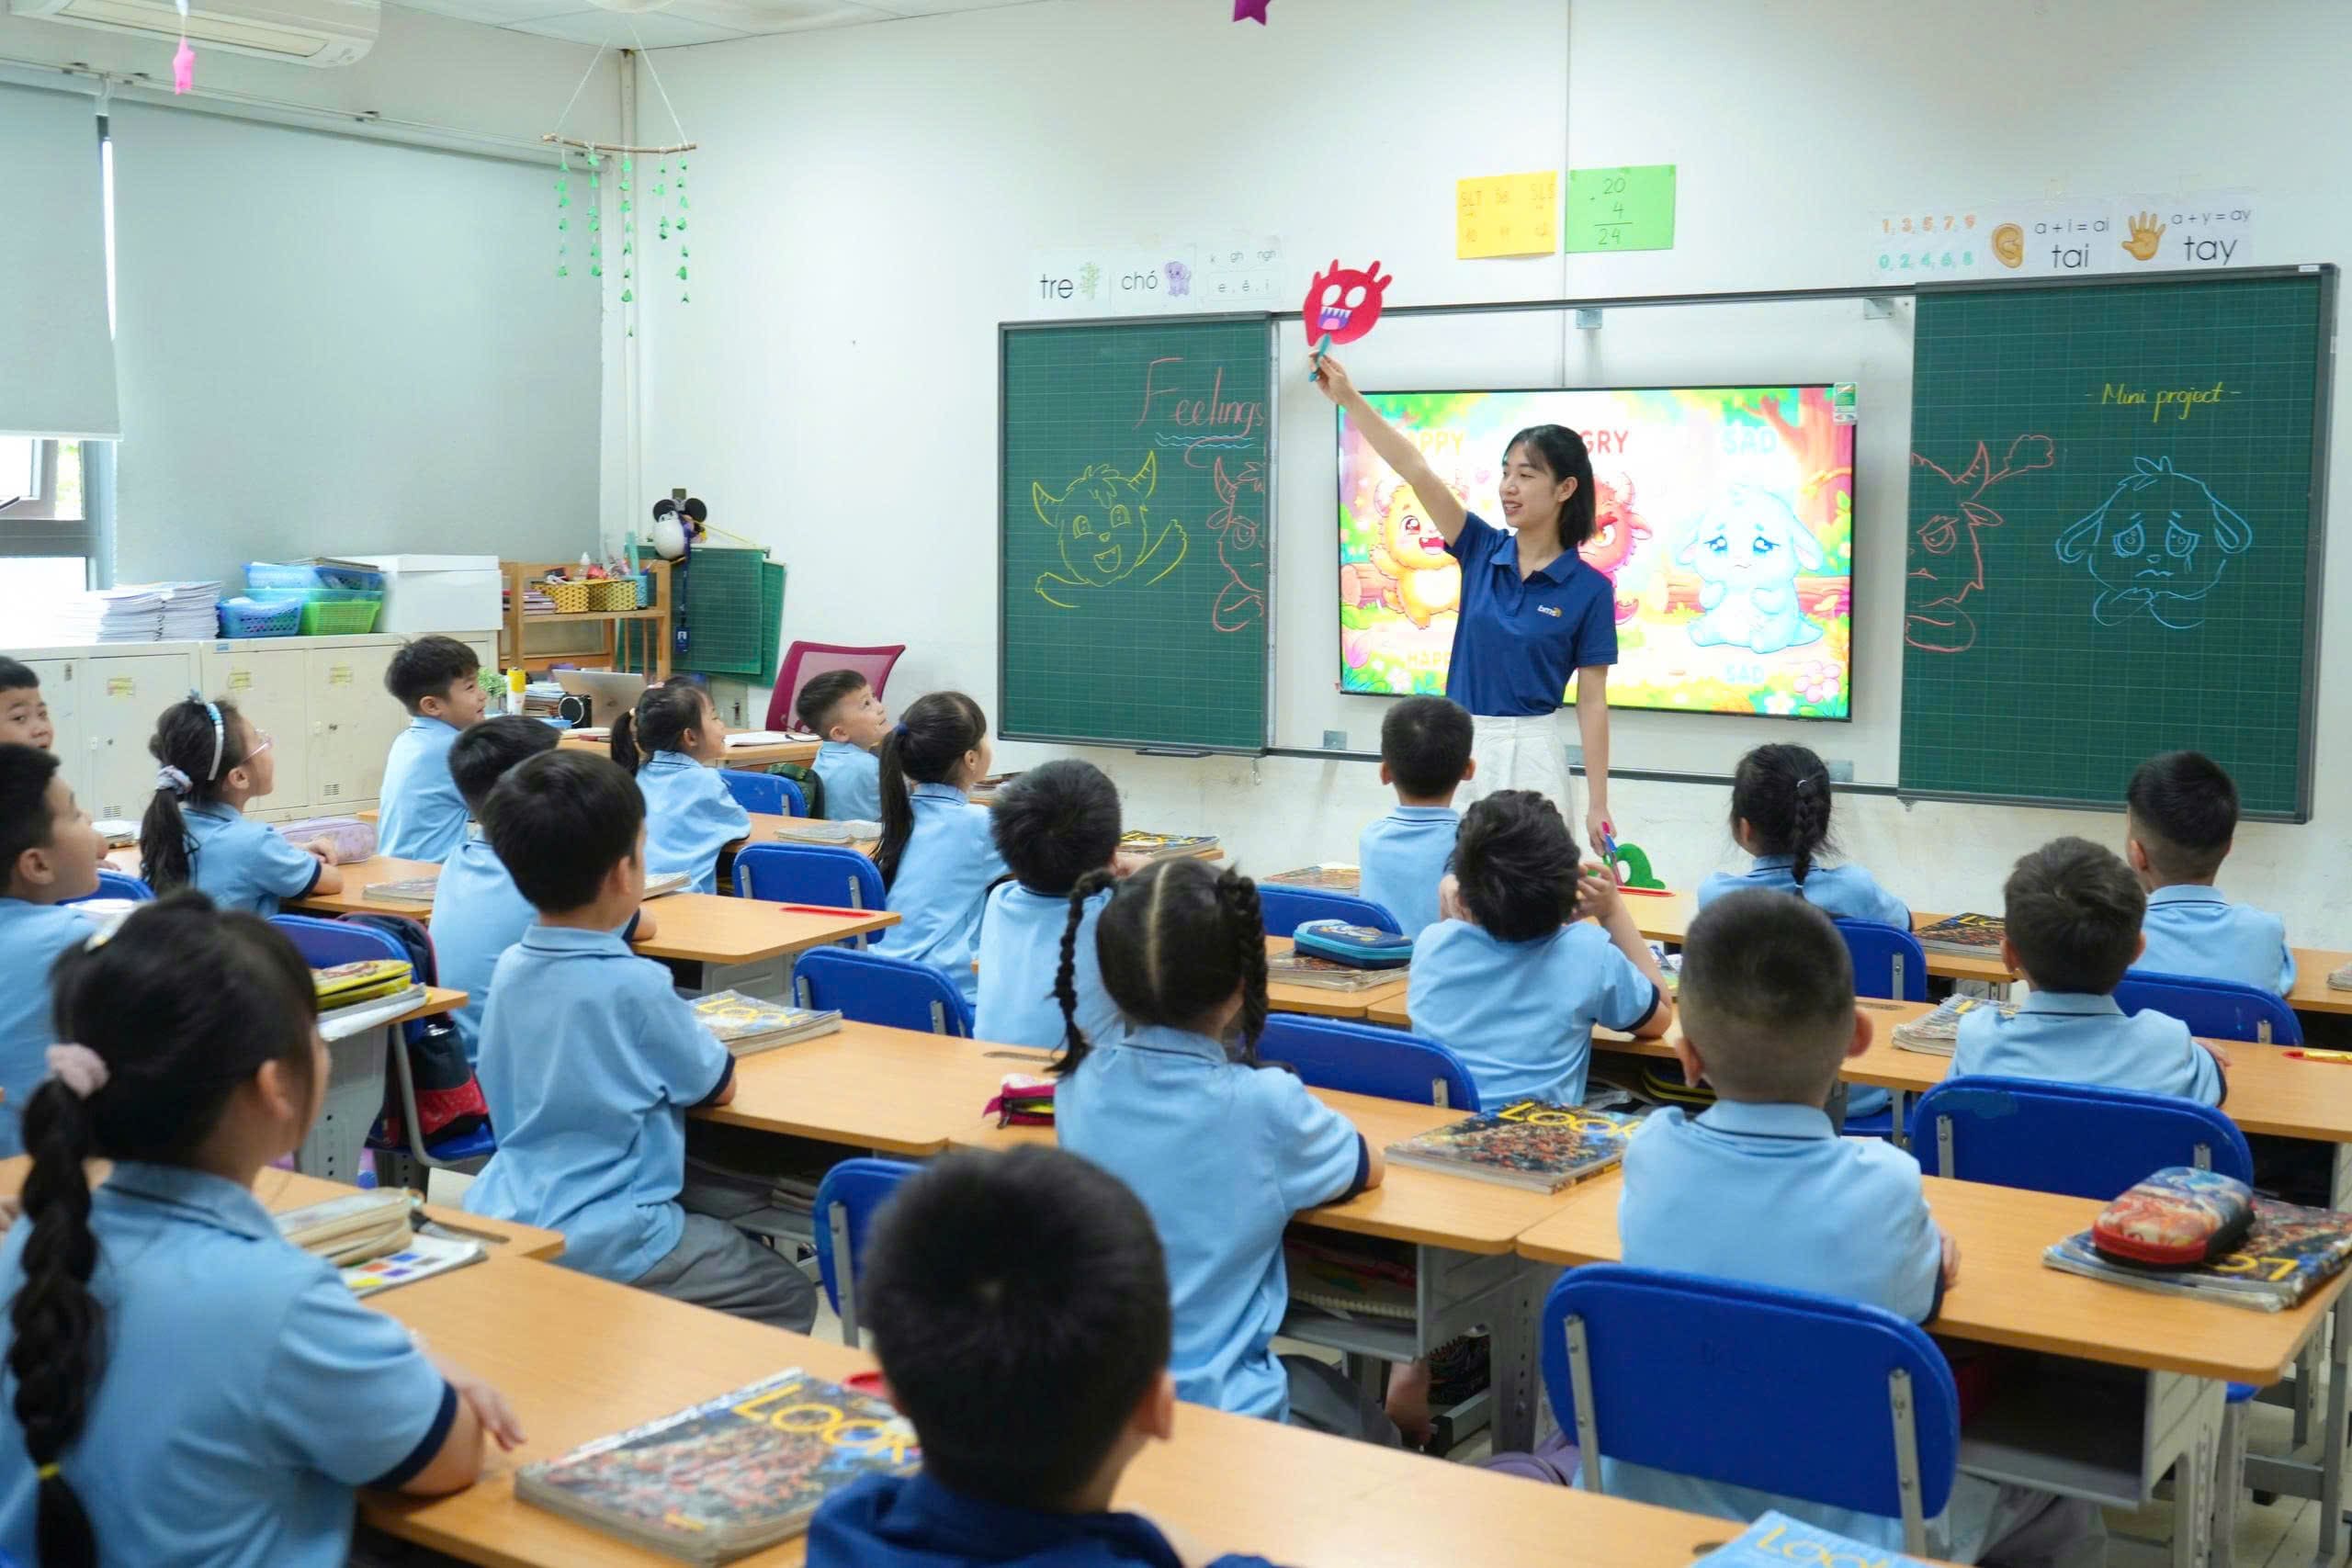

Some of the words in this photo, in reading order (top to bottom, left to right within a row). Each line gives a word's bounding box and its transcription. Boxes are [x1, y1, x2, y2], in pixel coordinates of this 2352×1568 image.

[1603, 177, 1626, 195] 20
[1612, 201, 1624, 220] 4
[2230, 209, 2253, 223] ay
[2093, 217, 2110, 232] ai
[1598, 227, 1622, 245] 24
[2050, 243, 2090, 268] tai
[2182, 235, 2238, 266] tay
[1040, 274, 1074, 299] tre
[1121, 270, 1159, 290] chó
[1133, 355, 1265, 467] Feelings
[2101, 383, 2146, 405] Mini
[2152, 381, 2224, 423] project
[1578, 430, 1629, 454] GRY
[1722, 426, 1778, 455] SAD
[1724, 662, 1765, 684] SAD
[1958, 915, 2006, 929] LO
